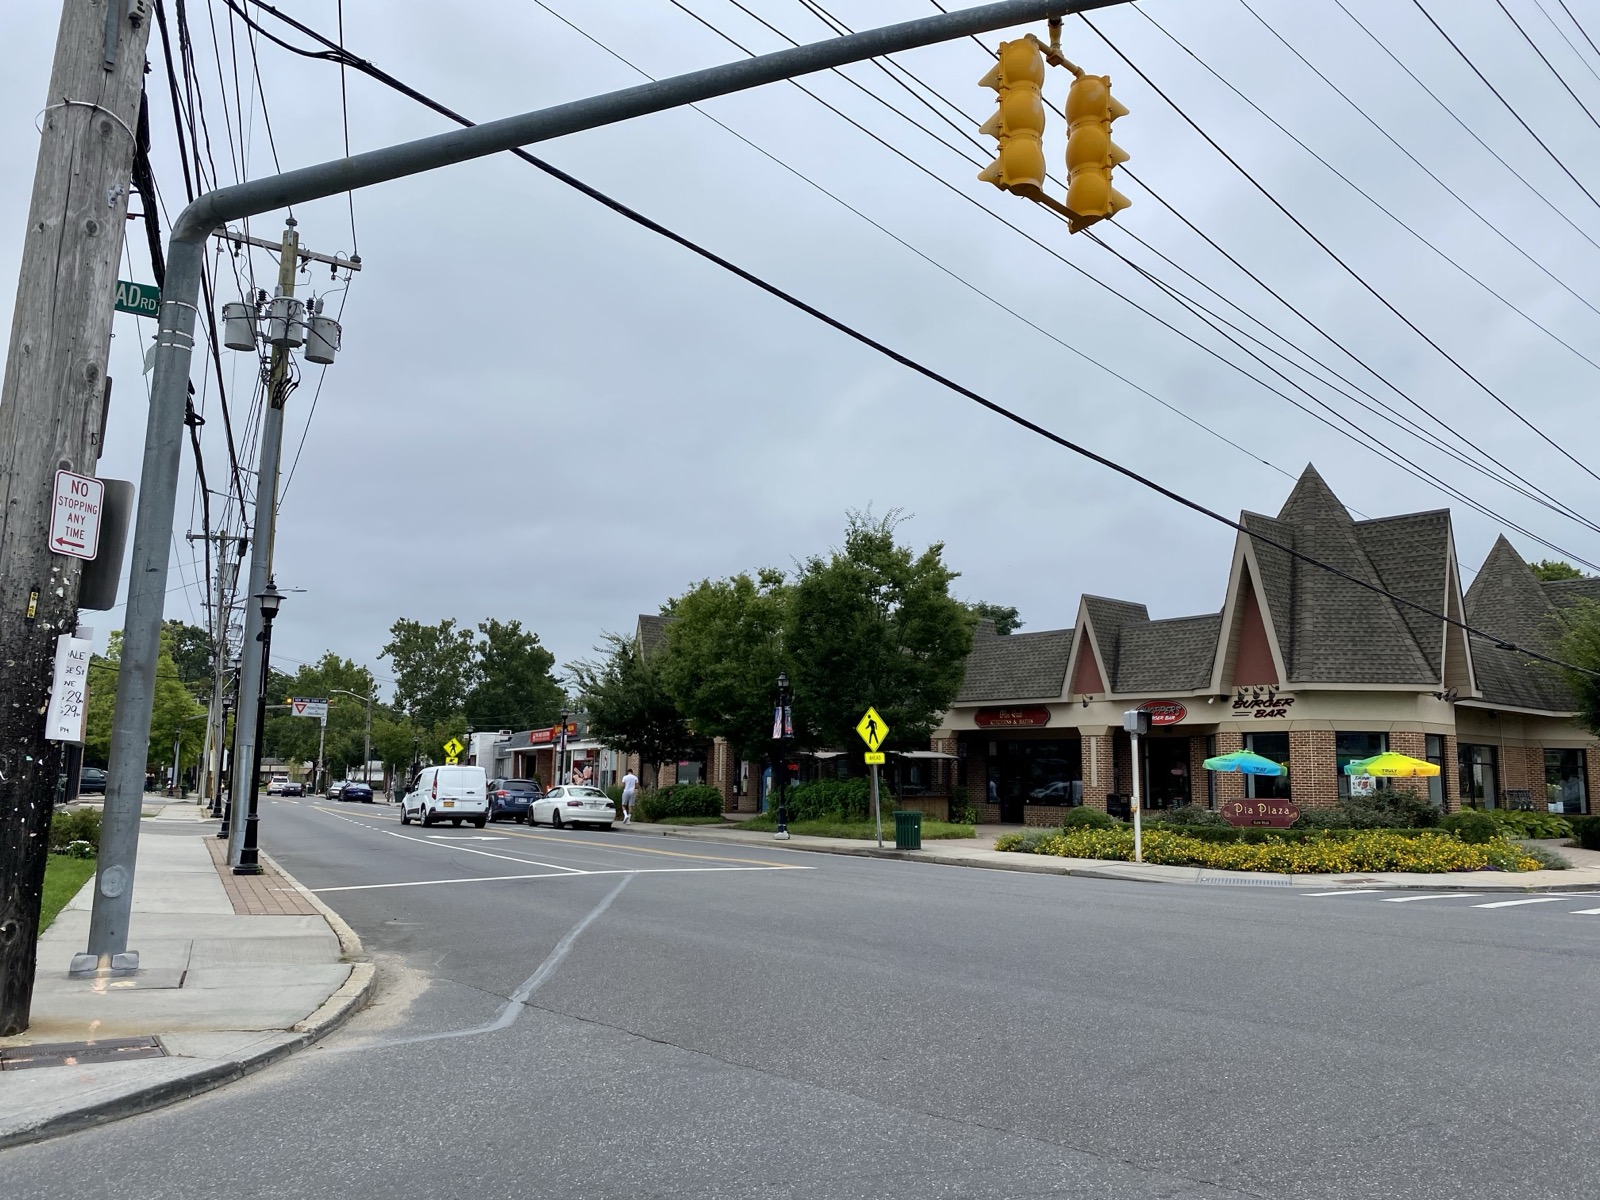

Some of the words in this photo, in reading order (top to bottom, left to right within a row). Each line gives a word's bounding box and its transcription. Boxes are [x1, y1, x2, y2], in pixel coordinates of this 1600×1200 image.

[140, 297, 157, 310] RD
[71, 480, 88, 497] NO
[58, 495, 98, 515] STOPPING
[67, 513, 86, 525] ANY
[65, 526, 85, 540] TIME
[67, 649, 86, 661] ALE
[1232, 698, 1295, 709] BURGER
[1254, 708, 1287, 718] BAR
[1234, 803, 1254, 816] Pia
[1258, 803, 1290, 816] Plaza
